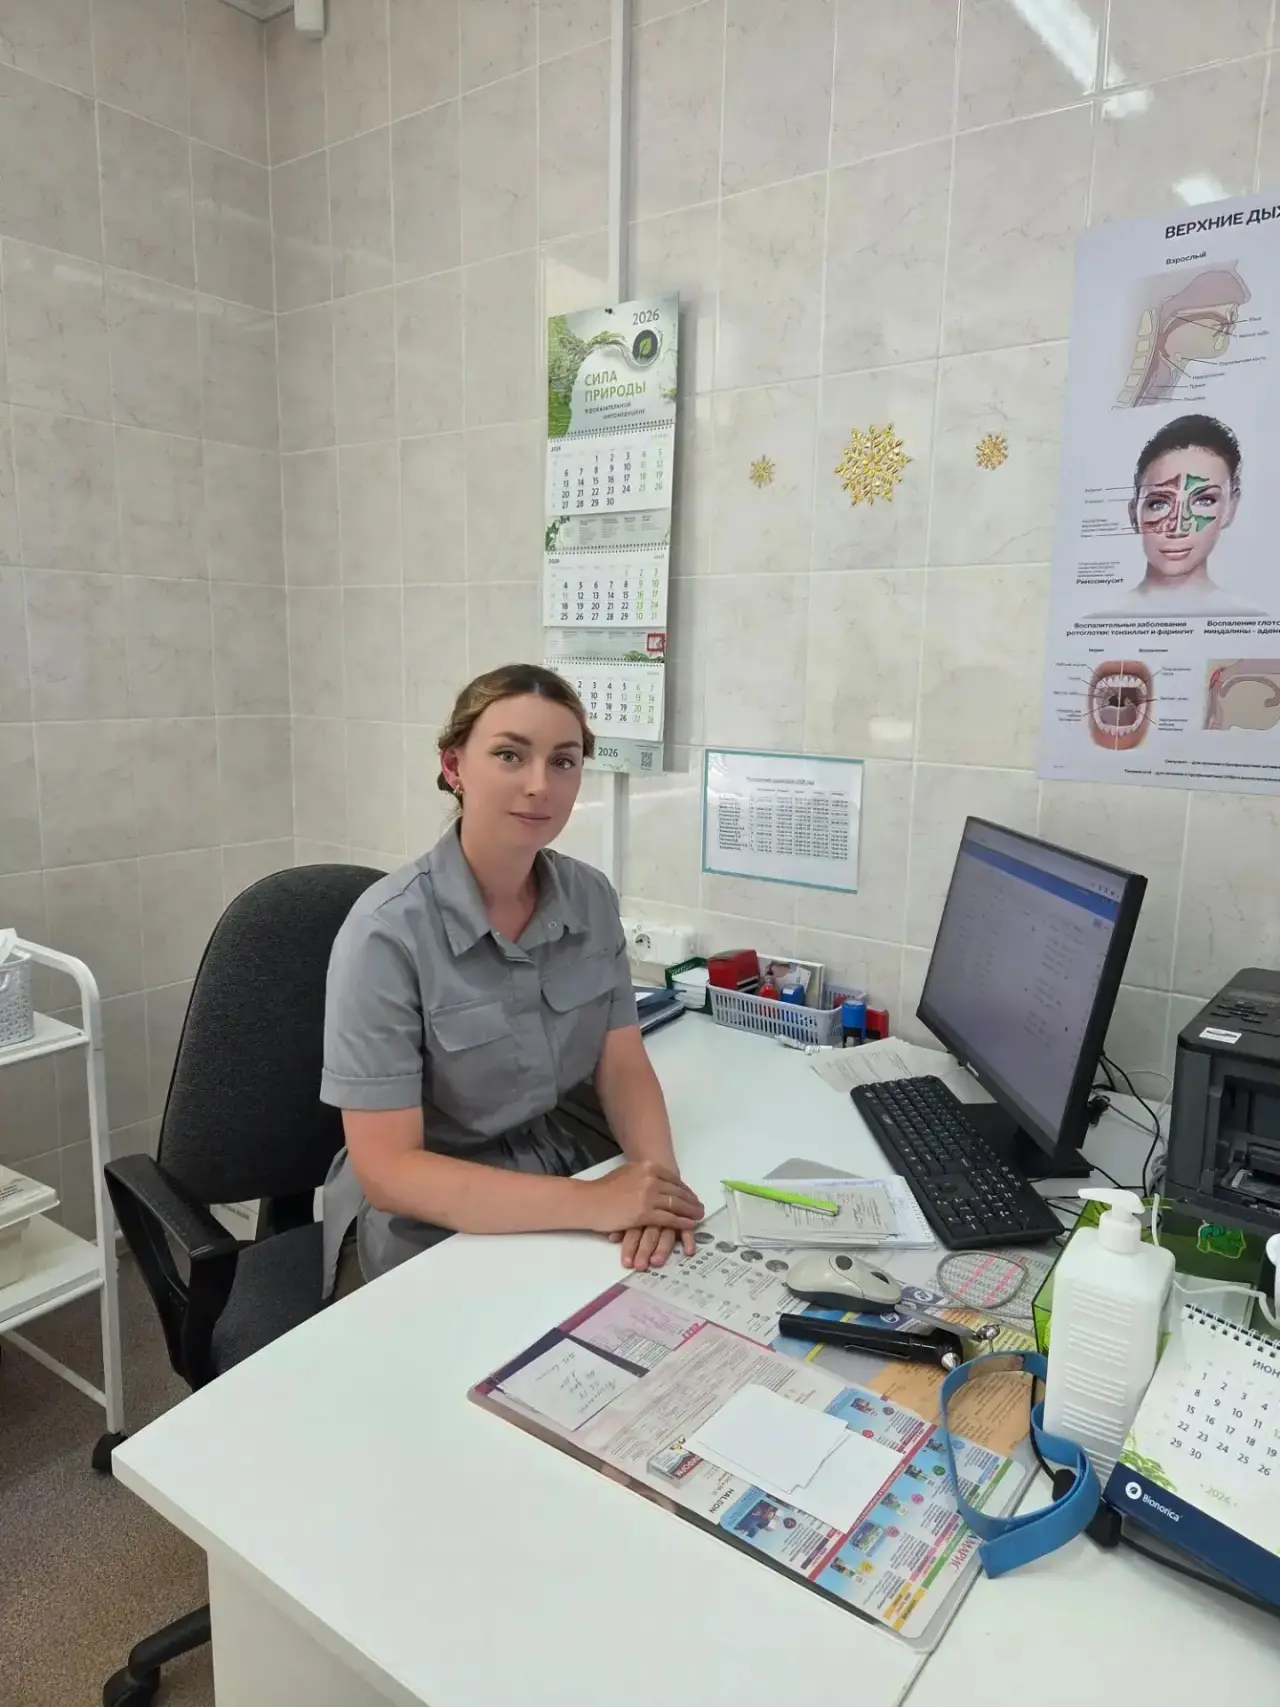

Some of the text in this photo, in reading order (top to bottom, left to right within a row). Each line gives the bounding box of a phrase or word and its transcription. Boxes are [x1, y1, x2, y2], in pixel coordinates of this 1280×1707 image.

[1165, 212, 1244, 239] ВЕРХНИЕ
[1166, 251, 1206, 265] Взрослый
[633, 309, 660, 326] 2026
[584, 370, 618, 386] СИЛА
[584, 382, 646, 402] ПРИРОДЫ
[626, 452, 630, 460] 3
[610, 464, 614, 472] 9
[592, 488, 599, 496] 22
[622, 485, 631, 493] 24
[562, 501, 568, 509] 27
[591, 499, 599, 507] 29
[606, 497, 614, 506] 30
[593, 592, 599, 600] 13
[606, 612, 614, 620] 28
[621, 612, 628, 620] 29
[606, 702, 612, 710] 18
[620, 704, 627, 712] 19
[604, 713, 612, 721] 25
[620, 714, 627, 722] 26
[598, 747, 618, 758] 2026
[1201, 1372, 1269, 1411] 1 2 3 4
[1194, 1389, 1201, 1397] 8
[1214, 1399, 1221, 1408] 9
[1232, 1408, 1243, 1419] 10
[1254, 1419, 1263, 1429] 11
[1186, 1404, 1278, 1458] 15 16 17 18 19
[1170, 1437, 1202, 1460] 29 30
[1177, 1420, 1271, 1476] 22 23 24 25 26
[709, 1488, 735, 1513] HALEON
[1142, 1493, 1180, 1522] Bionorica
